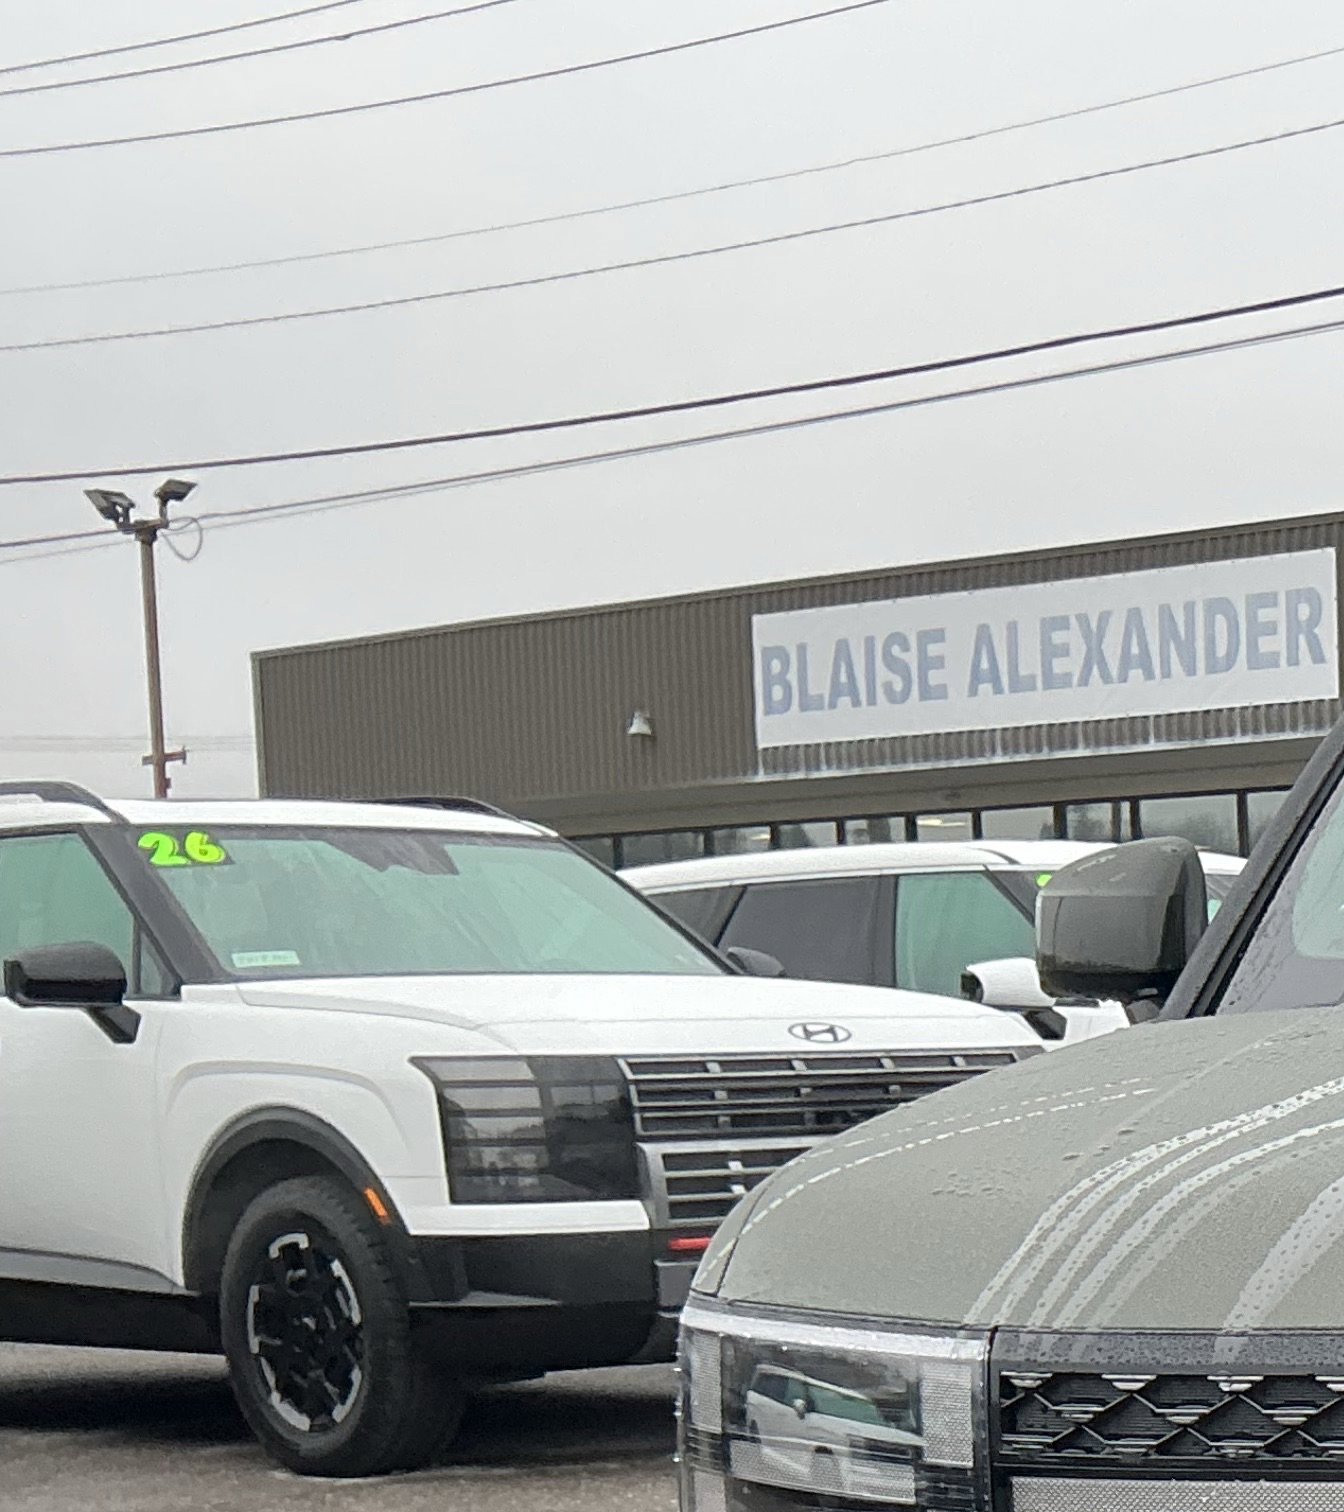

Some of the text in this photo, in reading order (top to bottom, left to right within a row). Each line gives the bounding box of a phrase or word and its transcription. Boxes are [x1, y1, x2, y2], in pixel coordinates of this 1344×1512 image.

[760, 586, 1328, 717] BLAISE ALEXANDER
[137, 831, 226, 866] 26
